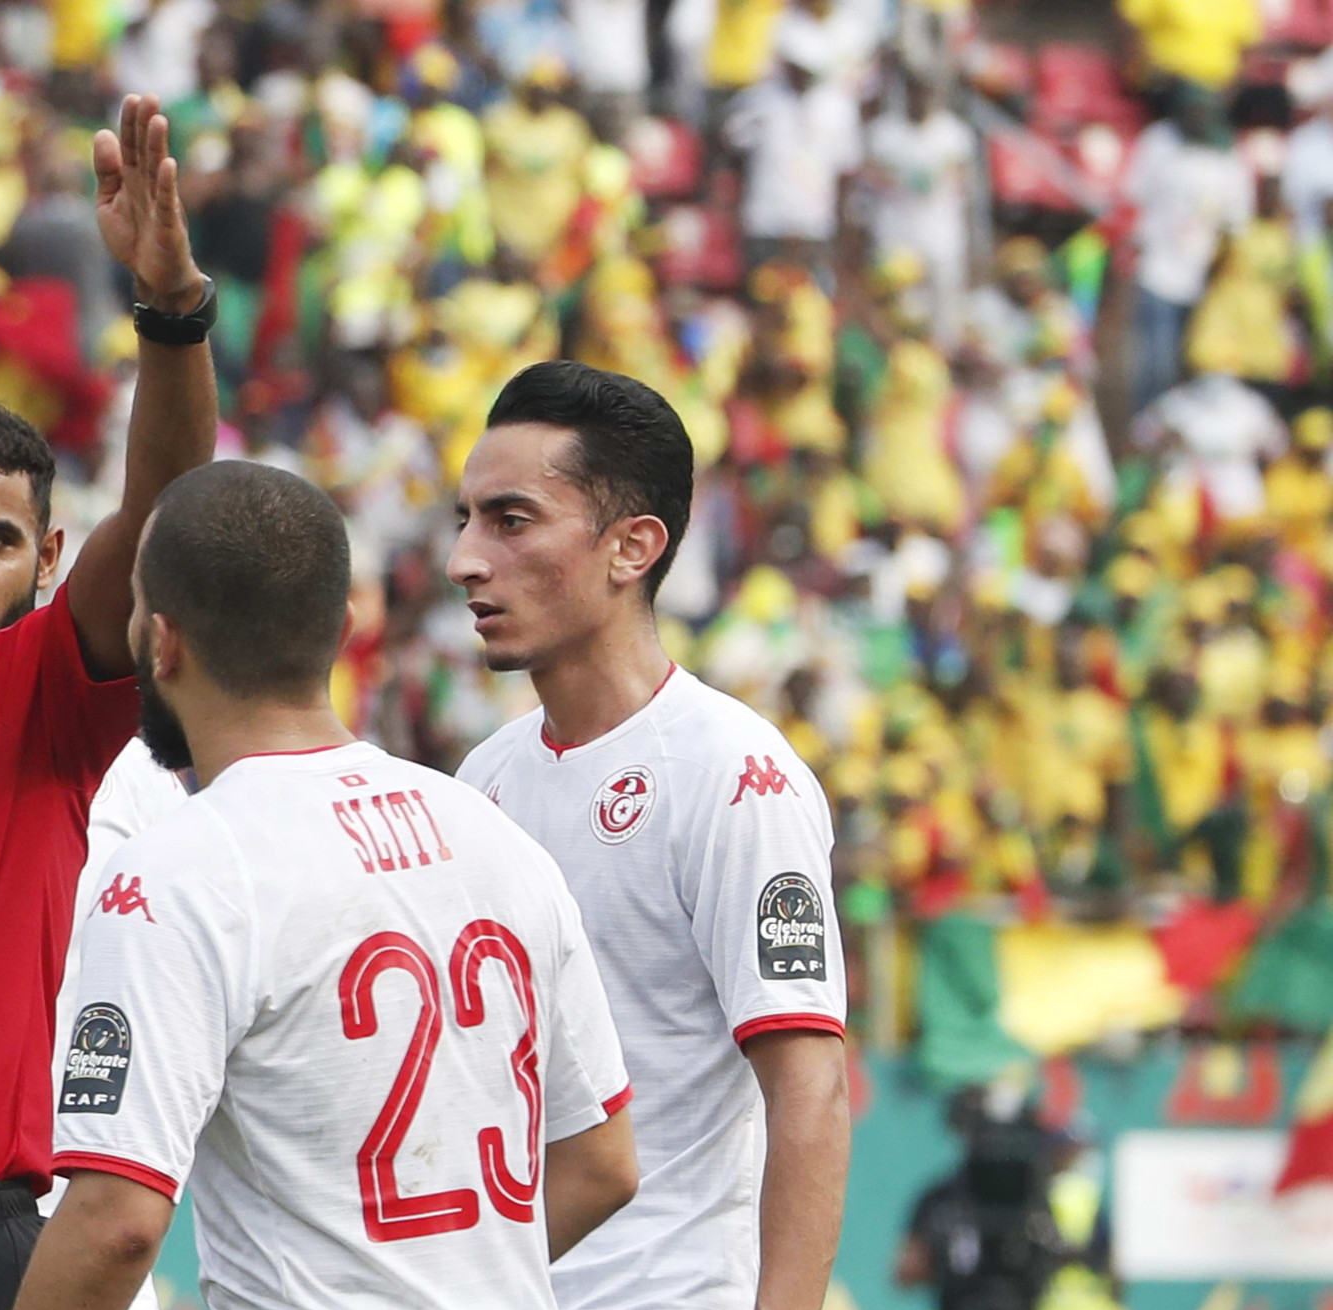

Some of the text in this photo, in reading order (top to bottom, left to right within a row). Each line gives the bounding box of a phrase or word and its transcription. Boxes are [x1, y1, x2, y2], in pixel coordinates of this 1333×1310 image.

[332, 789, 453, 874] SLITI
[760, 917, 824, 939] Celebrate
[773, 960, 819, 973] CAF
[338, 918, 542, 1243] 23
[64, 1093, 108, 1106] CAF
